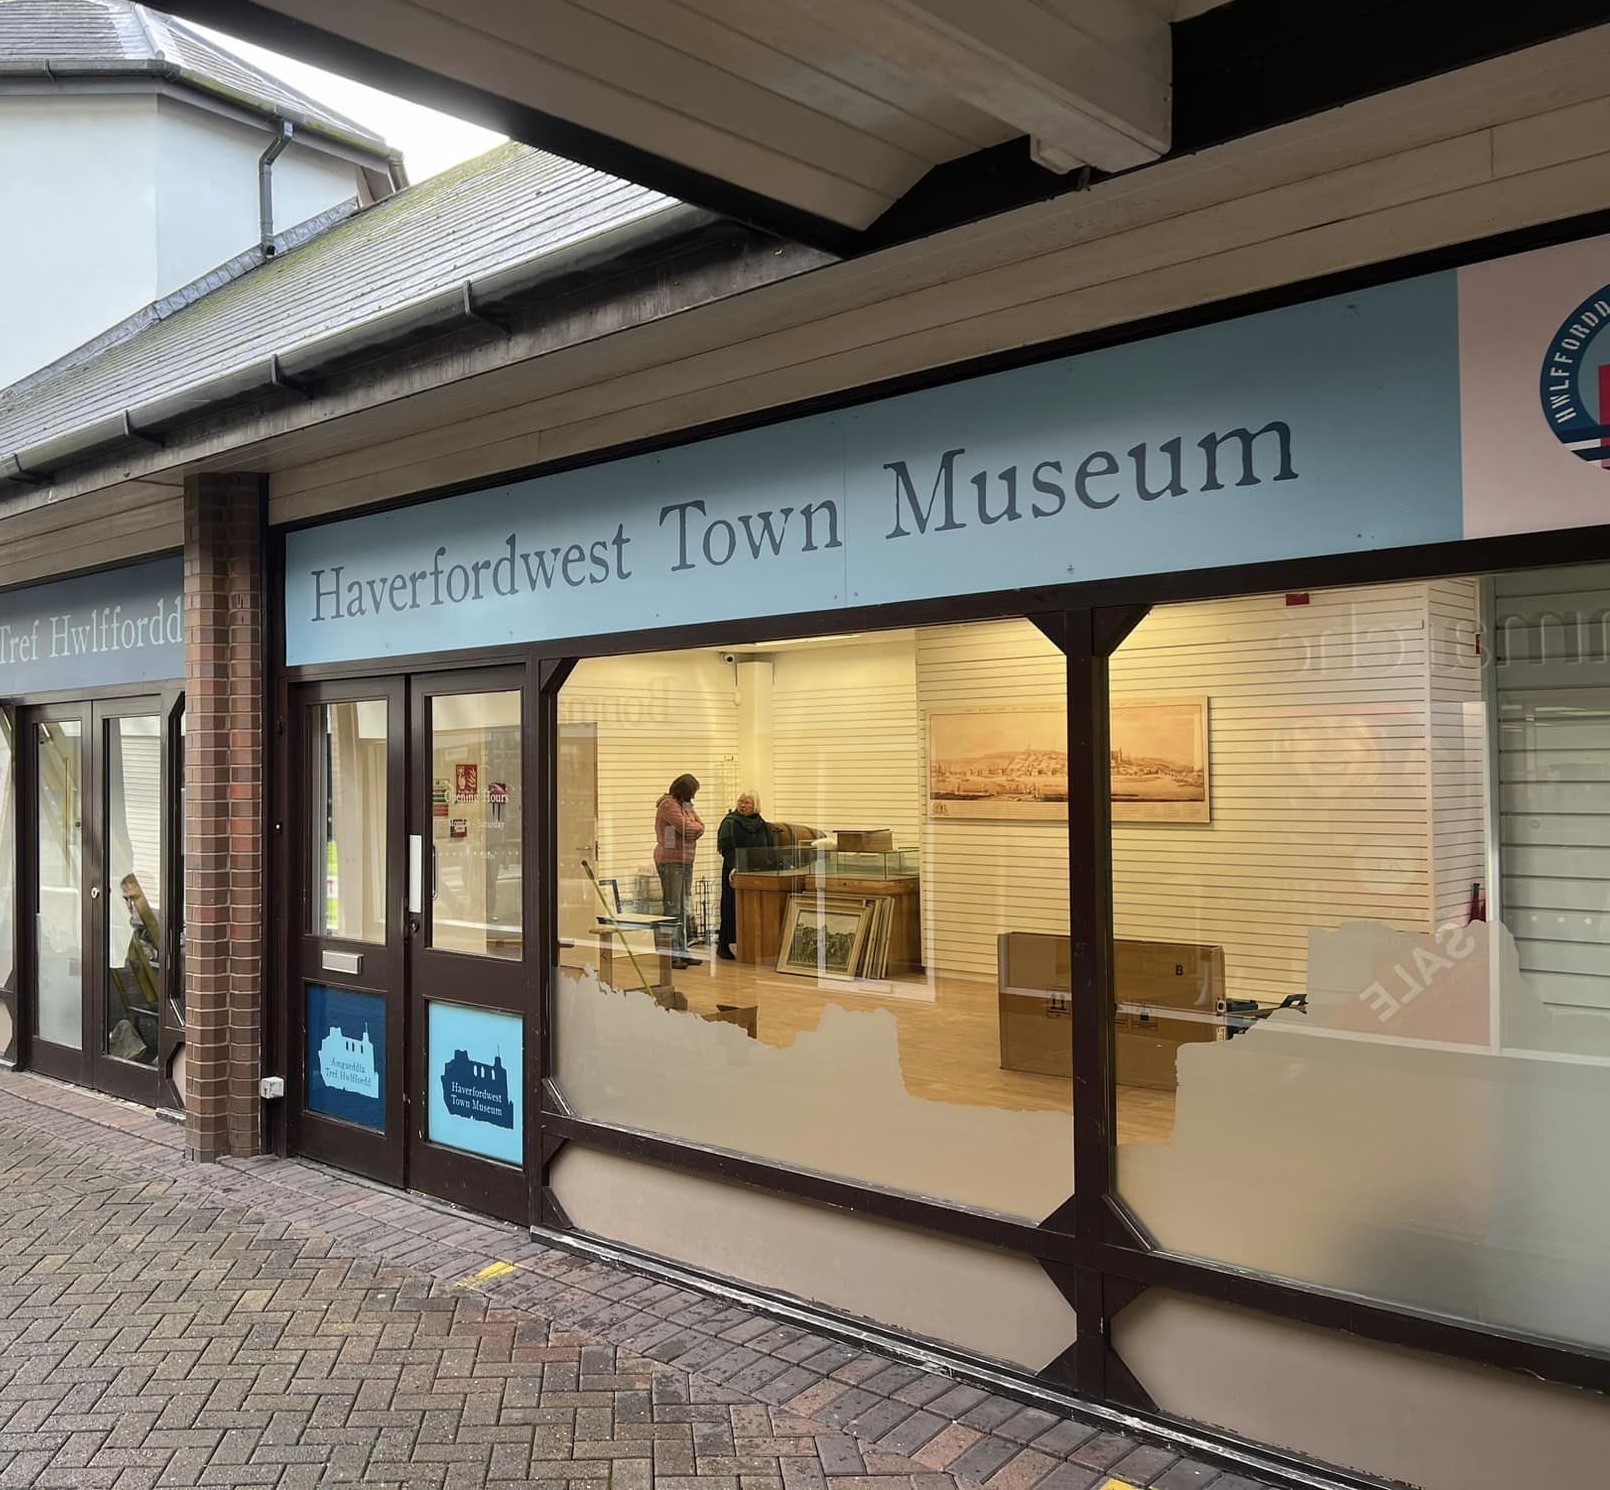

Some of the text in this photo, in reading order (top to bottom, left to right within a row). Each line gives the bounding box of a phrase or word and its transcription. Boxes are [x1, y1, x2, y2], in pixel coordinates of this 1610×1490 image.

[310, 420, 1299, 622] Haverfordwest Town Museum
[0, 595, 183, 664] Tref Hwlffordd
[444, 789, 510, 805] Opening Hours
[1175, 965, 1184, 976] B
[451, 1081, 502, 1104] Haverfordwest
[451, 1094, 503, 1116] Town Museum
